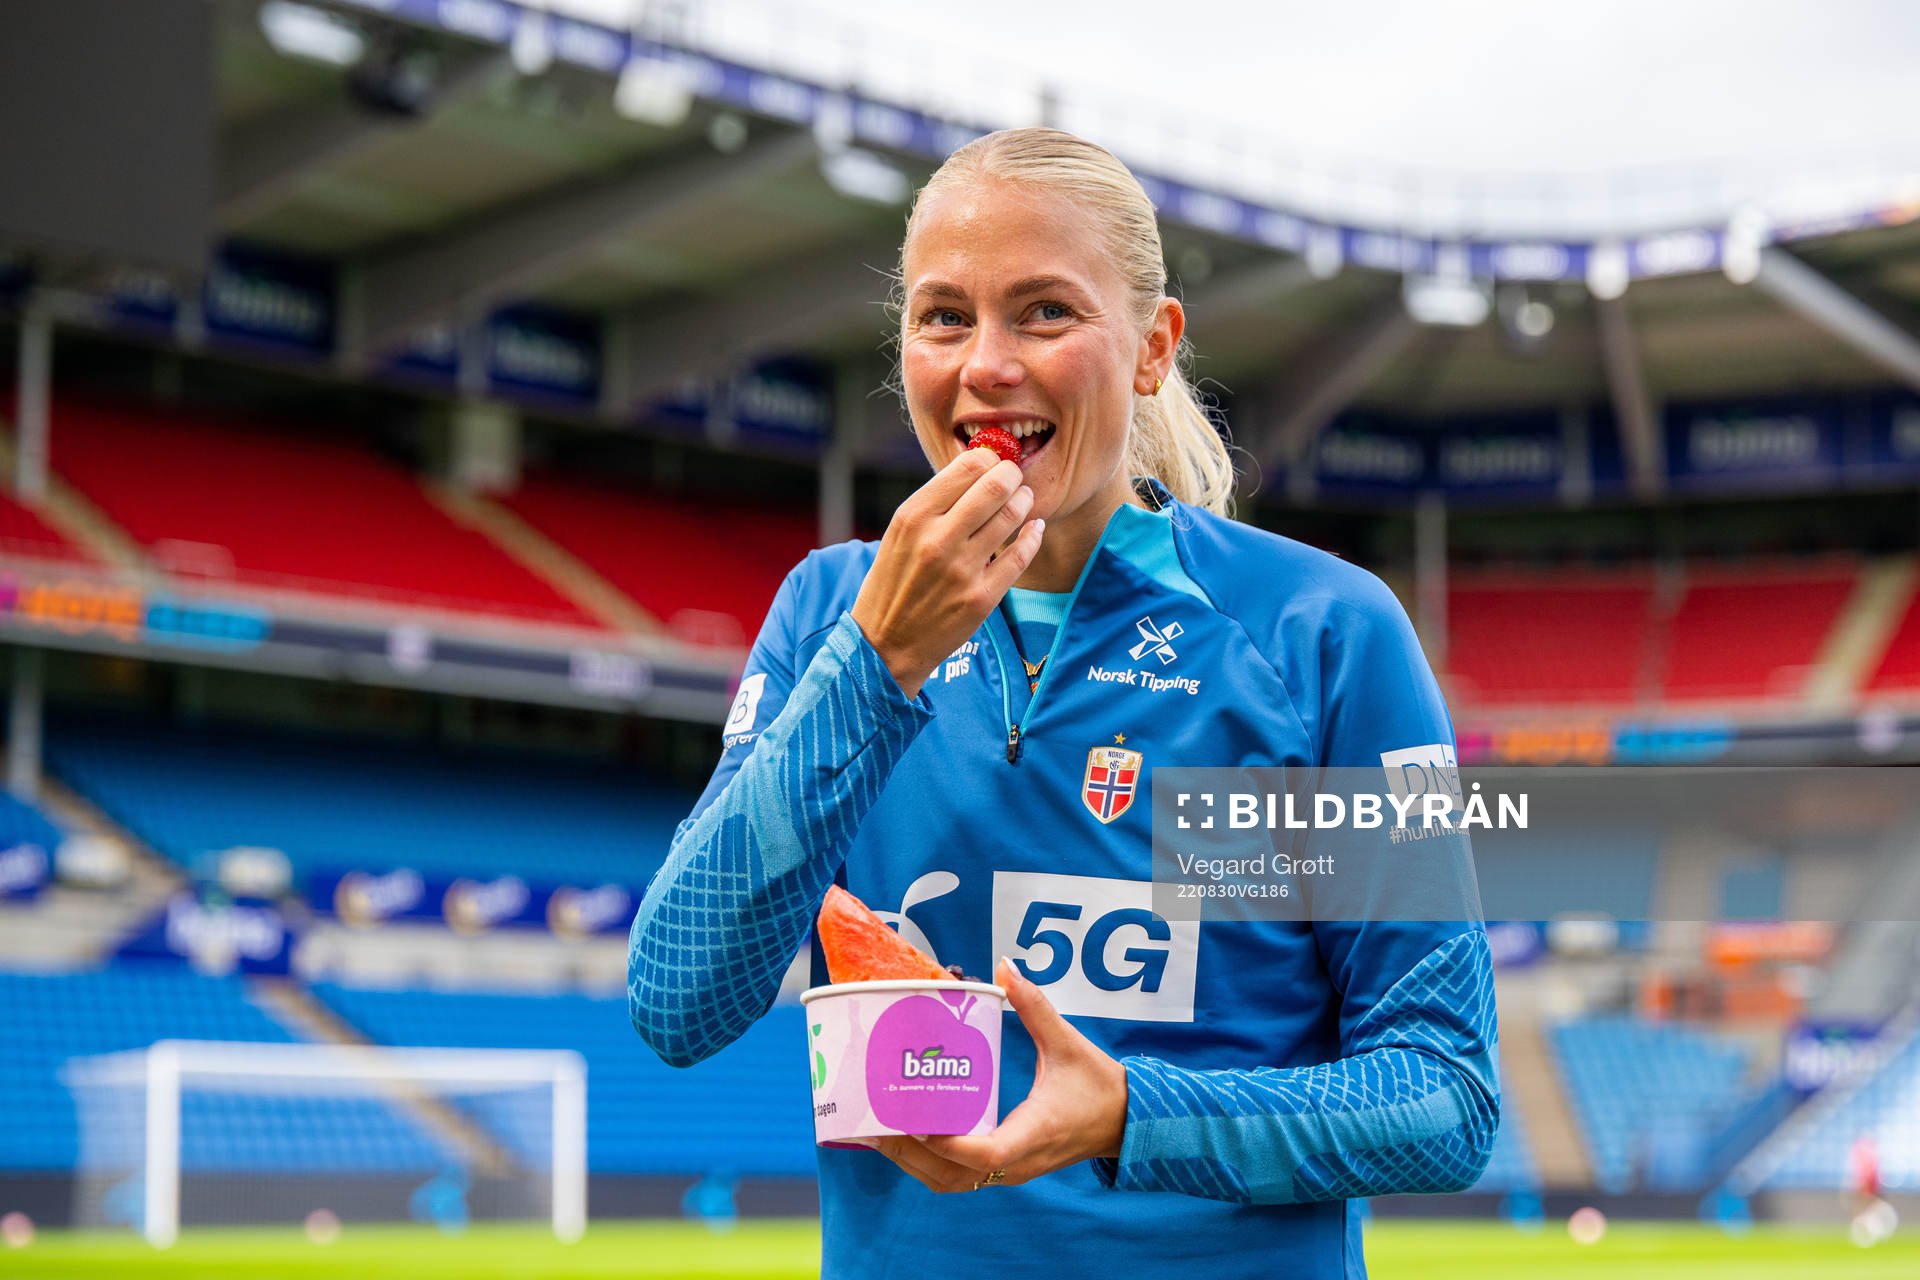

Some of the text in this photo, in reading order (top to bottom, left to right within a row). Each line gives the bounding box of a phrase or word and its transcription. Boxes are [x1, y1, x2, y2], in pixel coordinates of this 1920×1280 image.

[945, 653, 970, 683] pris
[1087, 665, 1201, 695] Norsk Tipping
[1012, 901, 1172, 993] 5G
[904, 1051, 971, 1077] bama
